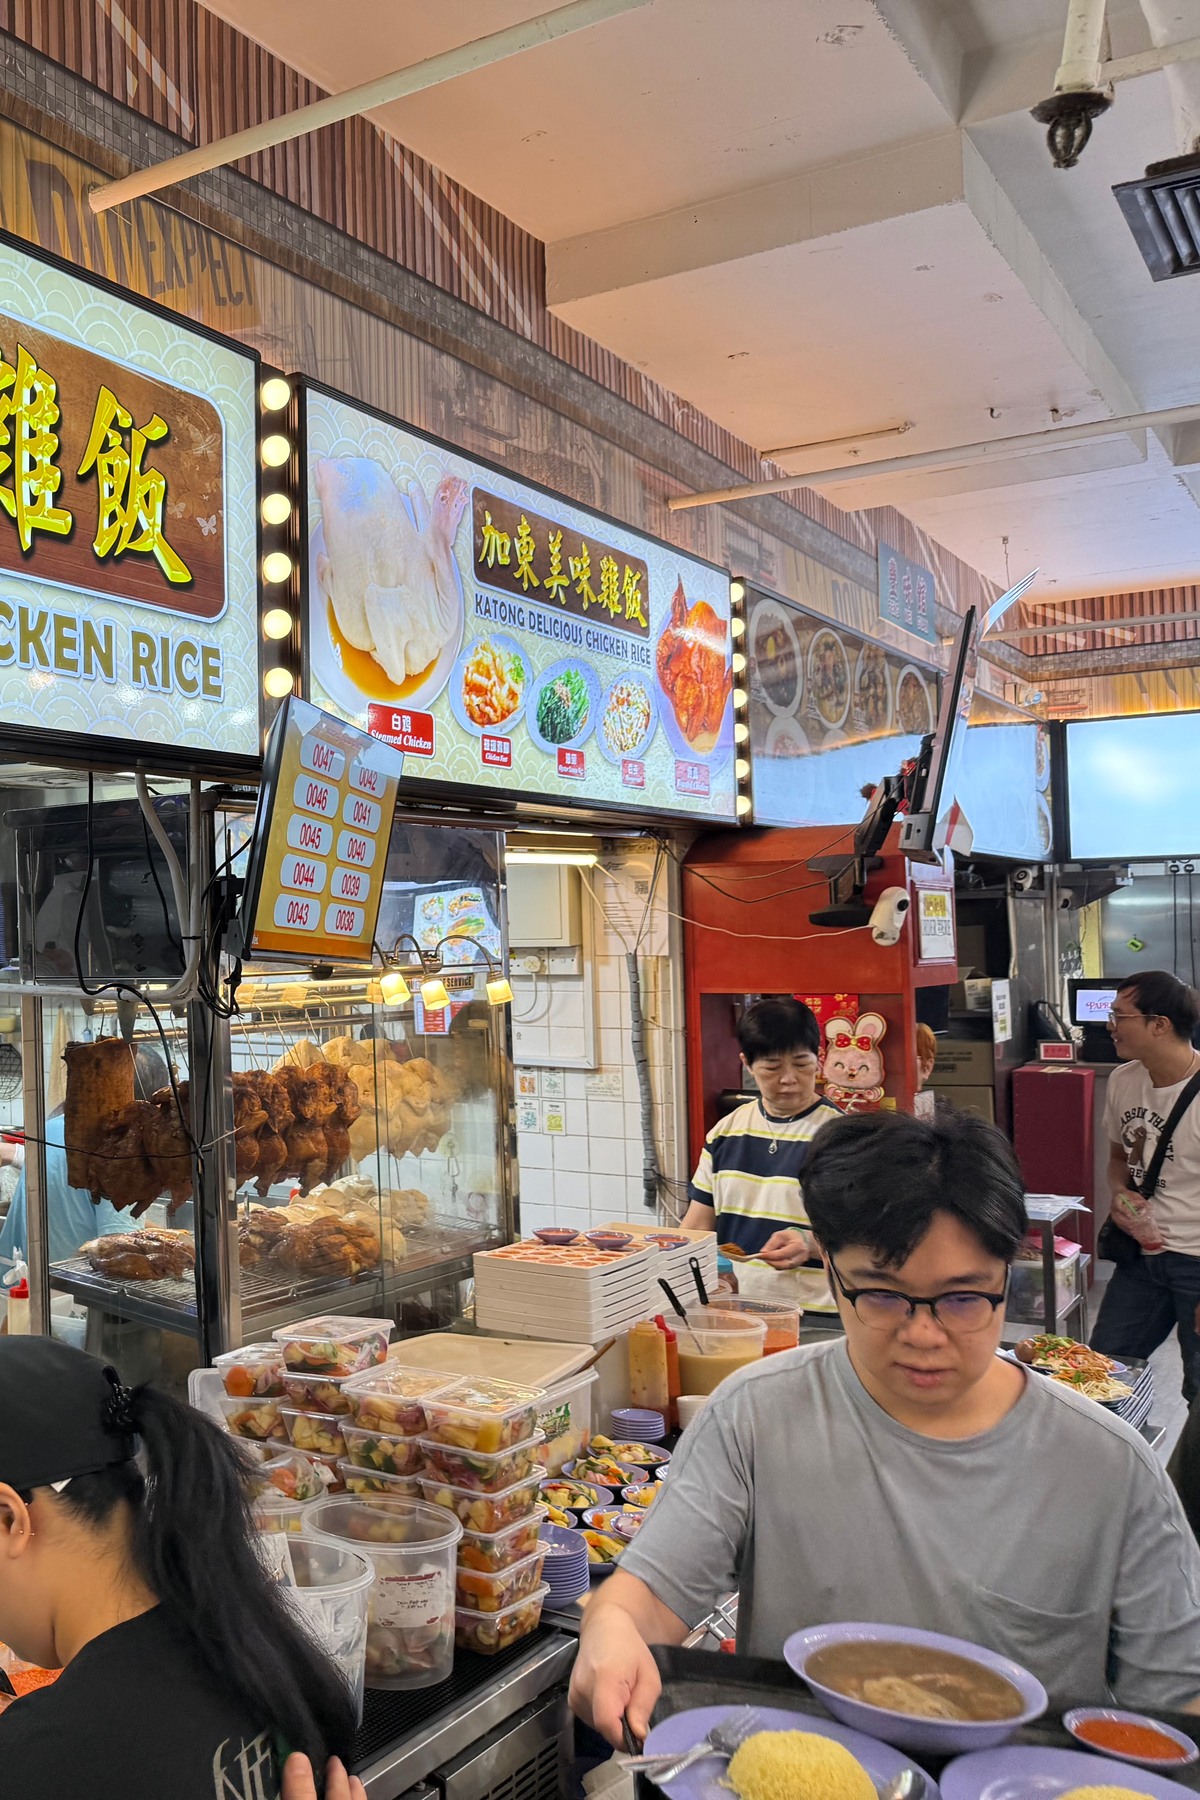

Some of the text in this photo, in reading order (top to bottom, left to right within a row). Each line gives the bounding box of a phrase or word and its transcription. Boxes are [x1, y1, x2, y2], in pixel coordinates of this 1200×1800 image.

[478, 511, 648, 629] 加東美味雞飯
[474, 593, 651, 666] KATONG DELICIOUS CHICKEN RICE
[132, 631, 224, 699] RICE
[371, 729, 403, 746] Steamed
[404, 734, 433, 750] Chicken
[312, 743, 335, 772] 0047
[359, 766, 378, 792] 0042
[305, 783, 328, 811] 0046
[353, 804, 372, 827] 0041
[299, 823, 321, 849] 0045
[347, 837, 366, 860] 0040
[293, 861, 315, 888] 0044
[341, 874, 360, 897] 0039
[287, 901, 309, 926] 0043
[335, 909, 355, 932] 0038
[447, 976, 472, 988] SERVICE
